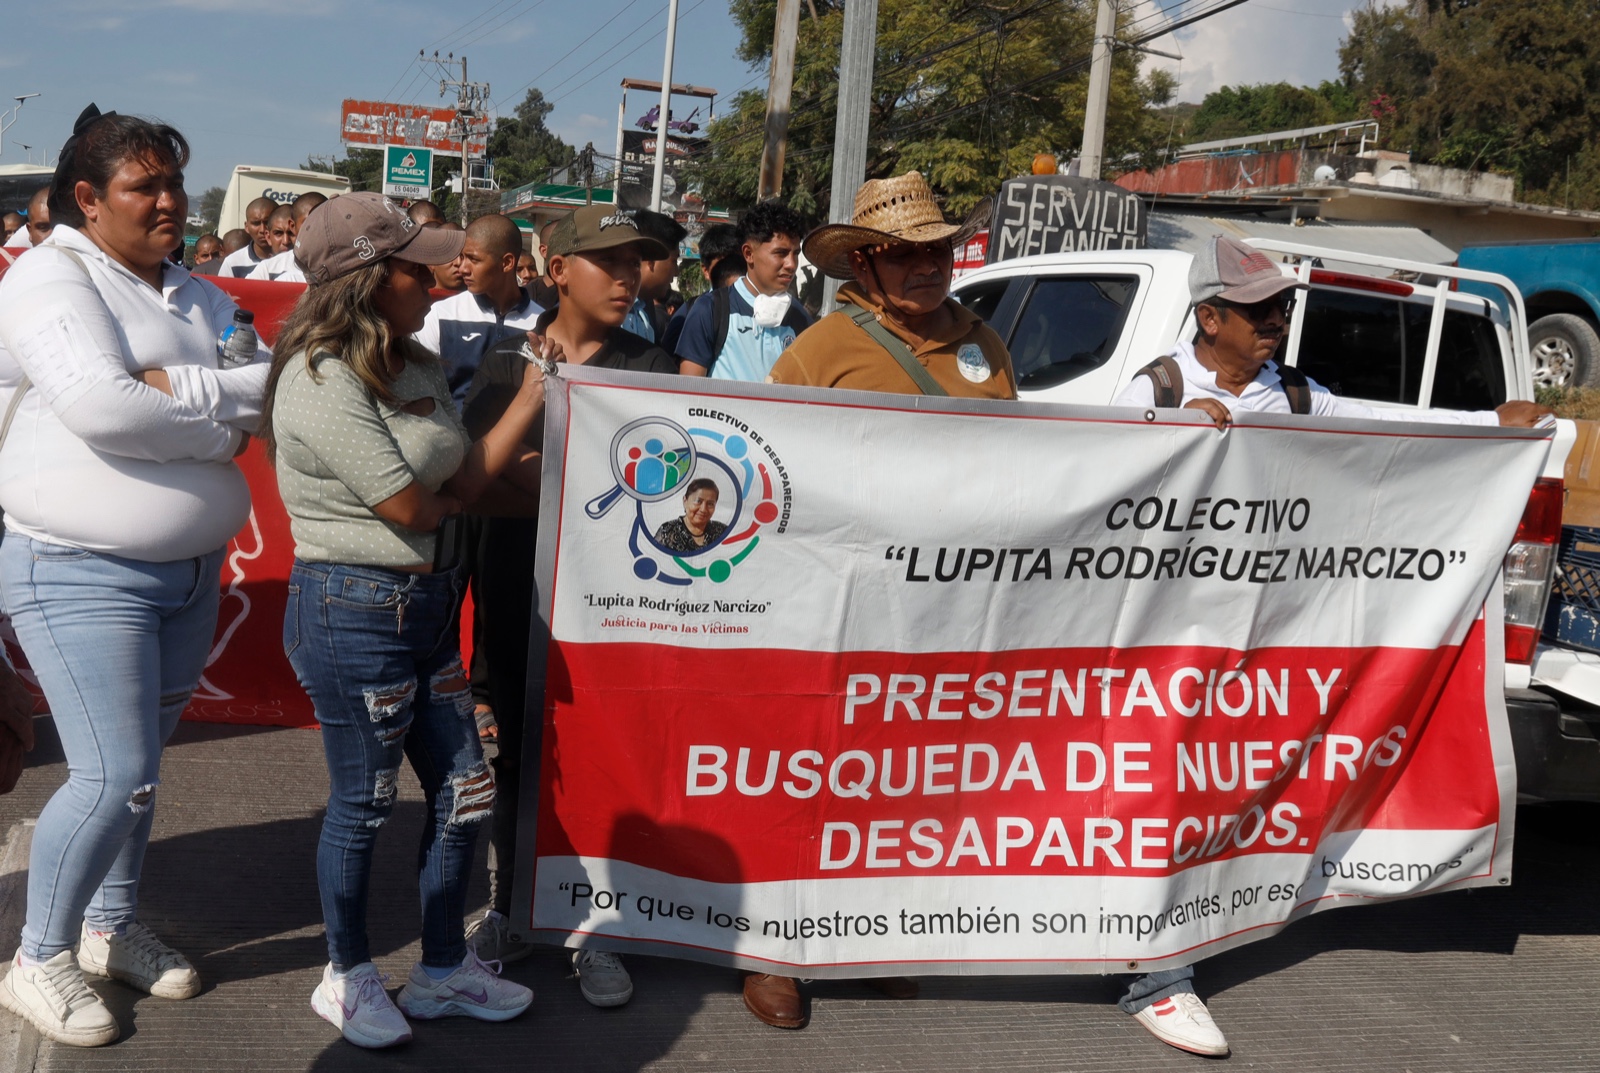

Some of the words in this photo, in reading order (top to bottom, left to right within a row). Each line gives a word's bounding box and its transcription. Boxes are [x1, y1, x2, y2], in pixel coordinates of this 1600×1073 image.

[391, 167, 425, 176] PEMEX
[1003, 182, 1139, 236] SERVICIO
[353, 235, 376, 261] 3
[966, 241, 985, 262] mts.
[688, 408, 749, 434] COLECTIVO
[749, 430, 764, 446] DE
[763, 444, 792, 534] DESAPARECIDOS
[1105, 496, 1311, 534] COLECTIVO
[885, 545, 1052, 583] “LUPITA
[1064, 537, 1291, 584] RODRÍGUEZ
[1294, 546, 1467, 582] NARCIZO”
[584, 593, 635, 610] “Lupita
[638, 595, 710, 616] Rodríguez
[713, 599, 772, 614] Narcizo”
[601, 614, 647, 628] Justicia
[649, 620, 678, 632] para
[681, 623, 698, 634] las
[701, 621, 749, 635] Víctimas
[843, 658, 1290, 725] PRESENTACIÓN
[1306, 667, 1343, 716] Y
[685, 741, 1047, 801] BUSQUEDA
[1065, 741, 1153, 793] DE
[819, 801, 1309, 871] DESAPARECIDOS.
[559, 882, 628, 911] “Por
[636, 895, 695, 922] que
[706, 906, 751, 932] los
[762, 910, 889, 941] nuestros
[899, 906, 1020, 935] también
[1032, 912, 1087, 935] son
[1099, 894, 1226, 942] importantes,
[1231, 885, 1263, 916] por
